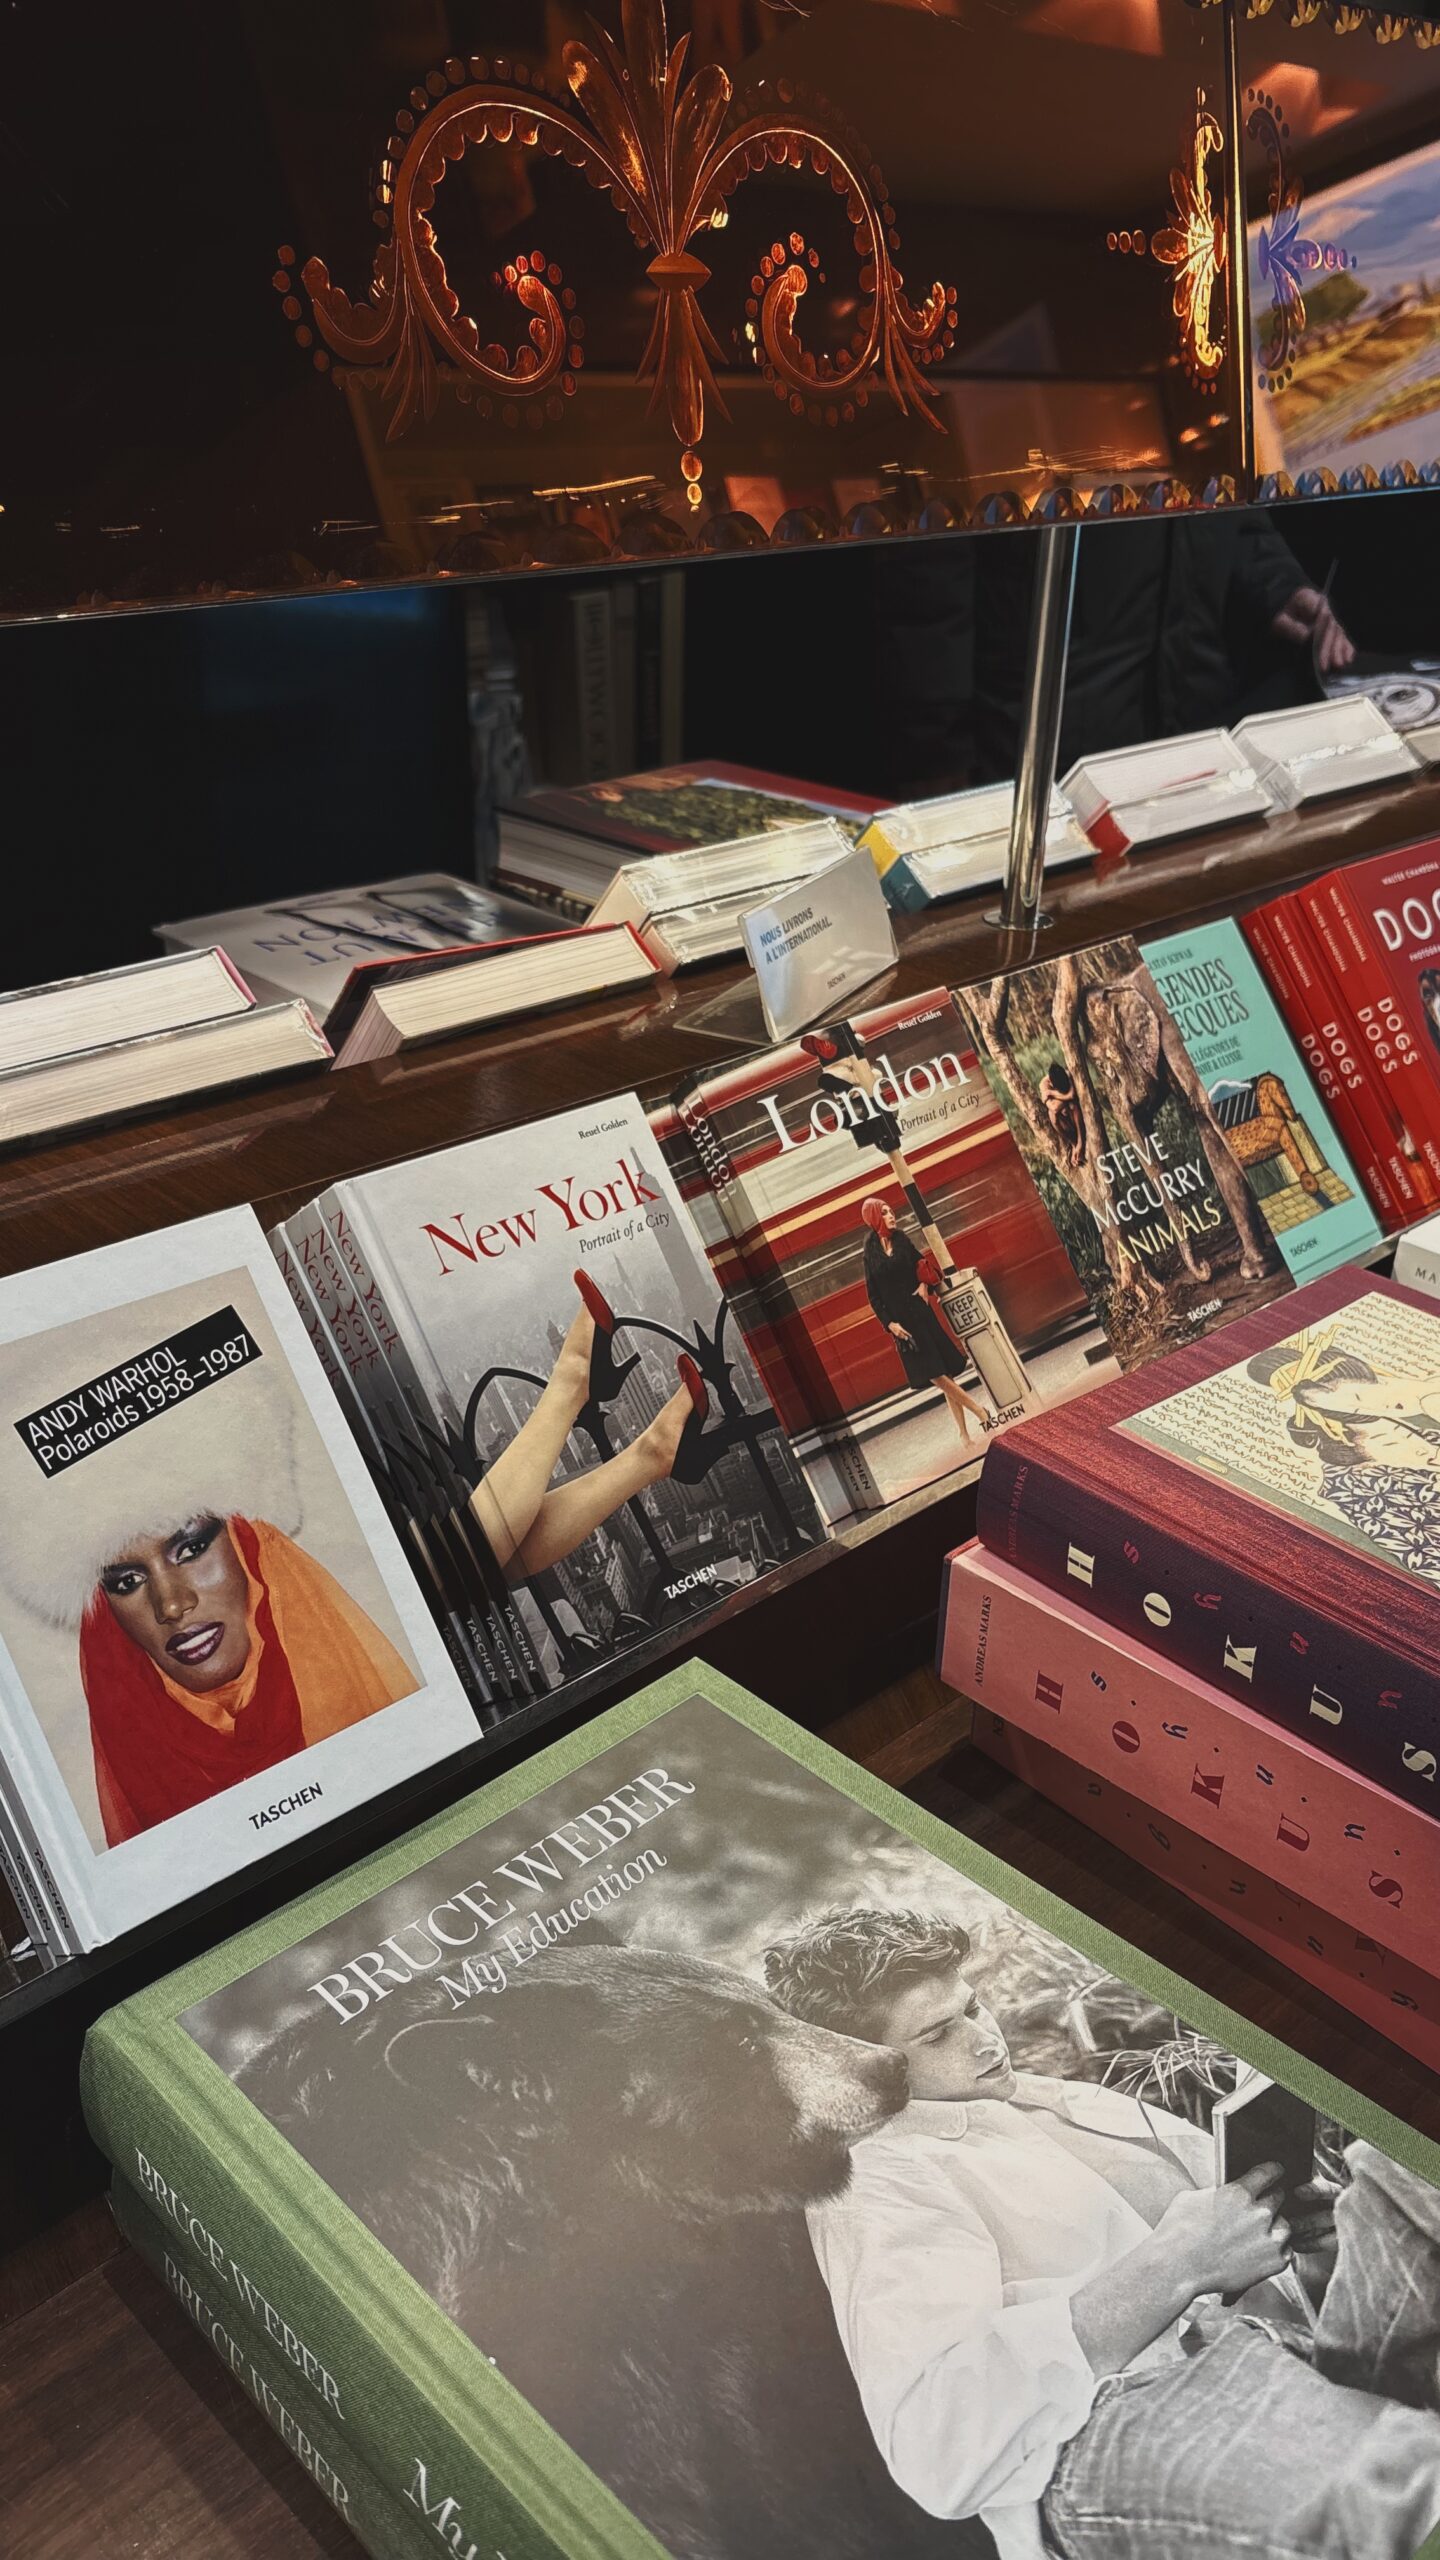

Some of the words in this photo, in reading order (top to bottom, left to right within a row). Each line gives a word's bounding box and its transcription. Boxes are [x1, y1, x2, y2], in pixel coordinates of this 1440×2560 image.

[760, 926, 782, 947] NOUS
[782, 907, 813, 934] LIVRONS
[1274, 915, 1289, 945] WALTER
[1309, 899, 1325, 930] WALTER
[1329, 887, 1344, 917] WALTER
[898, 1018, 918, 1031] Reuel
[918, 1009, 942, 1024] Golden
[1357, 1006, 1397, 1074] DOGS
[1377, 996, 1418, 1065] DOGS
[1301, 1033, 1340, 1099] DOGS
[1321, 1021, 1362, 1089] DOGS
[578, 1126, 601, 1140] Reuel
[601, 1118, 628, 1133] Golden
[757, 1053, 972, 1153] London
[900, 1112, 936, 1132] Portrait
[939, 1102, 950, 1121] of
[958, 1092, 980, 1112] City
[688, 1096, 737, 1196] London
[1097, 1132, 1169, 1184] STEVE
[1388, 1156, 1413, 1199] TASCHEN
[419, 1213, 536, 1276] New
[535, 1159, 661, 1231] York
[1091, 1159, 1205, 1233] McCURRY
[1367, 1166, 1391, 1209] TASCHEN
[579, 1228, 621, 1253] Portrait
[623, 1222, 636, 1240] of
[637, 1222, 644, 1233] a
[645, 1212, 670, 1229] City
[1117, 1197, 1221, 1271] ANIMALS
[1290, 1237, 1319, 1258] TASCHEN
[296, 1235, 330, 1301] New
[330, 1304, 362, 1377] York
[312, 1226, 346, 1292] New
[346, 1295, 379, 1369] York
[329, 1209, 365, 1279] New
[364, 1279, 399, 1357] York
[949, 1295, 975, 1317] KEEP
[1187, 1298, 1222, 1322] TASCHEN
[276, 1250, 309, 1313] New
[309, 1316, 340, 1388] York
[954, 1308, 981, 1330] LEFT
[27, 1394, 89, 1446] ANDY
[88, 1346, 187, 1409] WARHOL
[979, 1404, 1025, 1433] TASCHEN
[37, 1403, 140, 1470] Polaroids
[1012, 1464, 1029, 1512] MARKS
[663, 1563, 718, 1599] TASCHEN
[442, 1625, 473, 1688] TASCHEN
[466, 1617, 498, 1682] TASCHEN
[485, 1615, 518, 1680] TASCHEN
[504, 1605, 536, 1671] TASCHEN
[974, 1635, 988, 1686] ANDREAS
[981, 1595, 992, 1637] MARKS
[249, 1782, 323, 1830] TASCHEN
[16, 1852, 51, 1931] TASCHEN
[34, 1849, 69, 1930] TASCHEN
[306, 1880, 517, 2025] BRUCE
[492, 1768, 696, 1895] WEBER
[434, 1956, 508, 2011] My
[497, 1848, 668, 1967] Education
[135, 2147, 228, 2283] BRUCE
[228, 2258, 345, 2420] WEBER
[162, 2250, 246, 2385] BRUCE
[248, 2363, 352, 2525] WEBER
